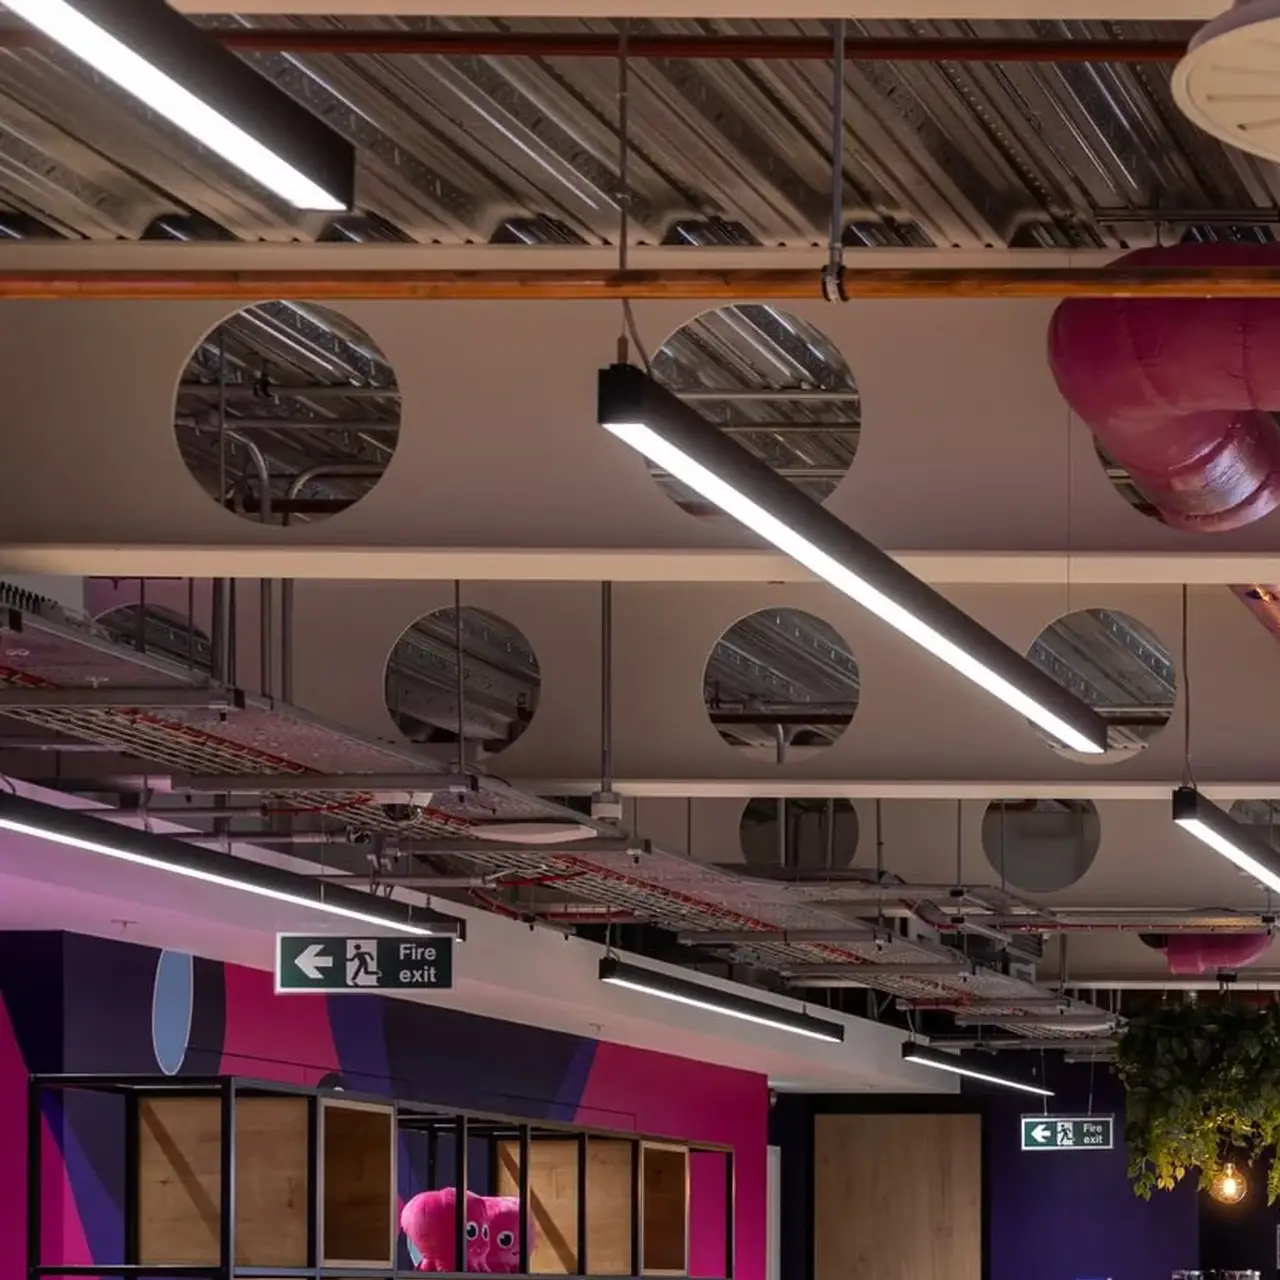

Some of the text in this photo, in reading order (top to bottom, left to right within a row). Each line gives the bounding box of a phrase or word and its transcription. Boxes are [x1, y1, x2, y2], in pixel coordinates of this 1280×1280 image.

[399, 943, 437, 960] Fire
[399, 965, 437, 982] exit
[1083, 1123, 1102, 1133] Fire
[1083, 1134, 1103, 1144] exit
